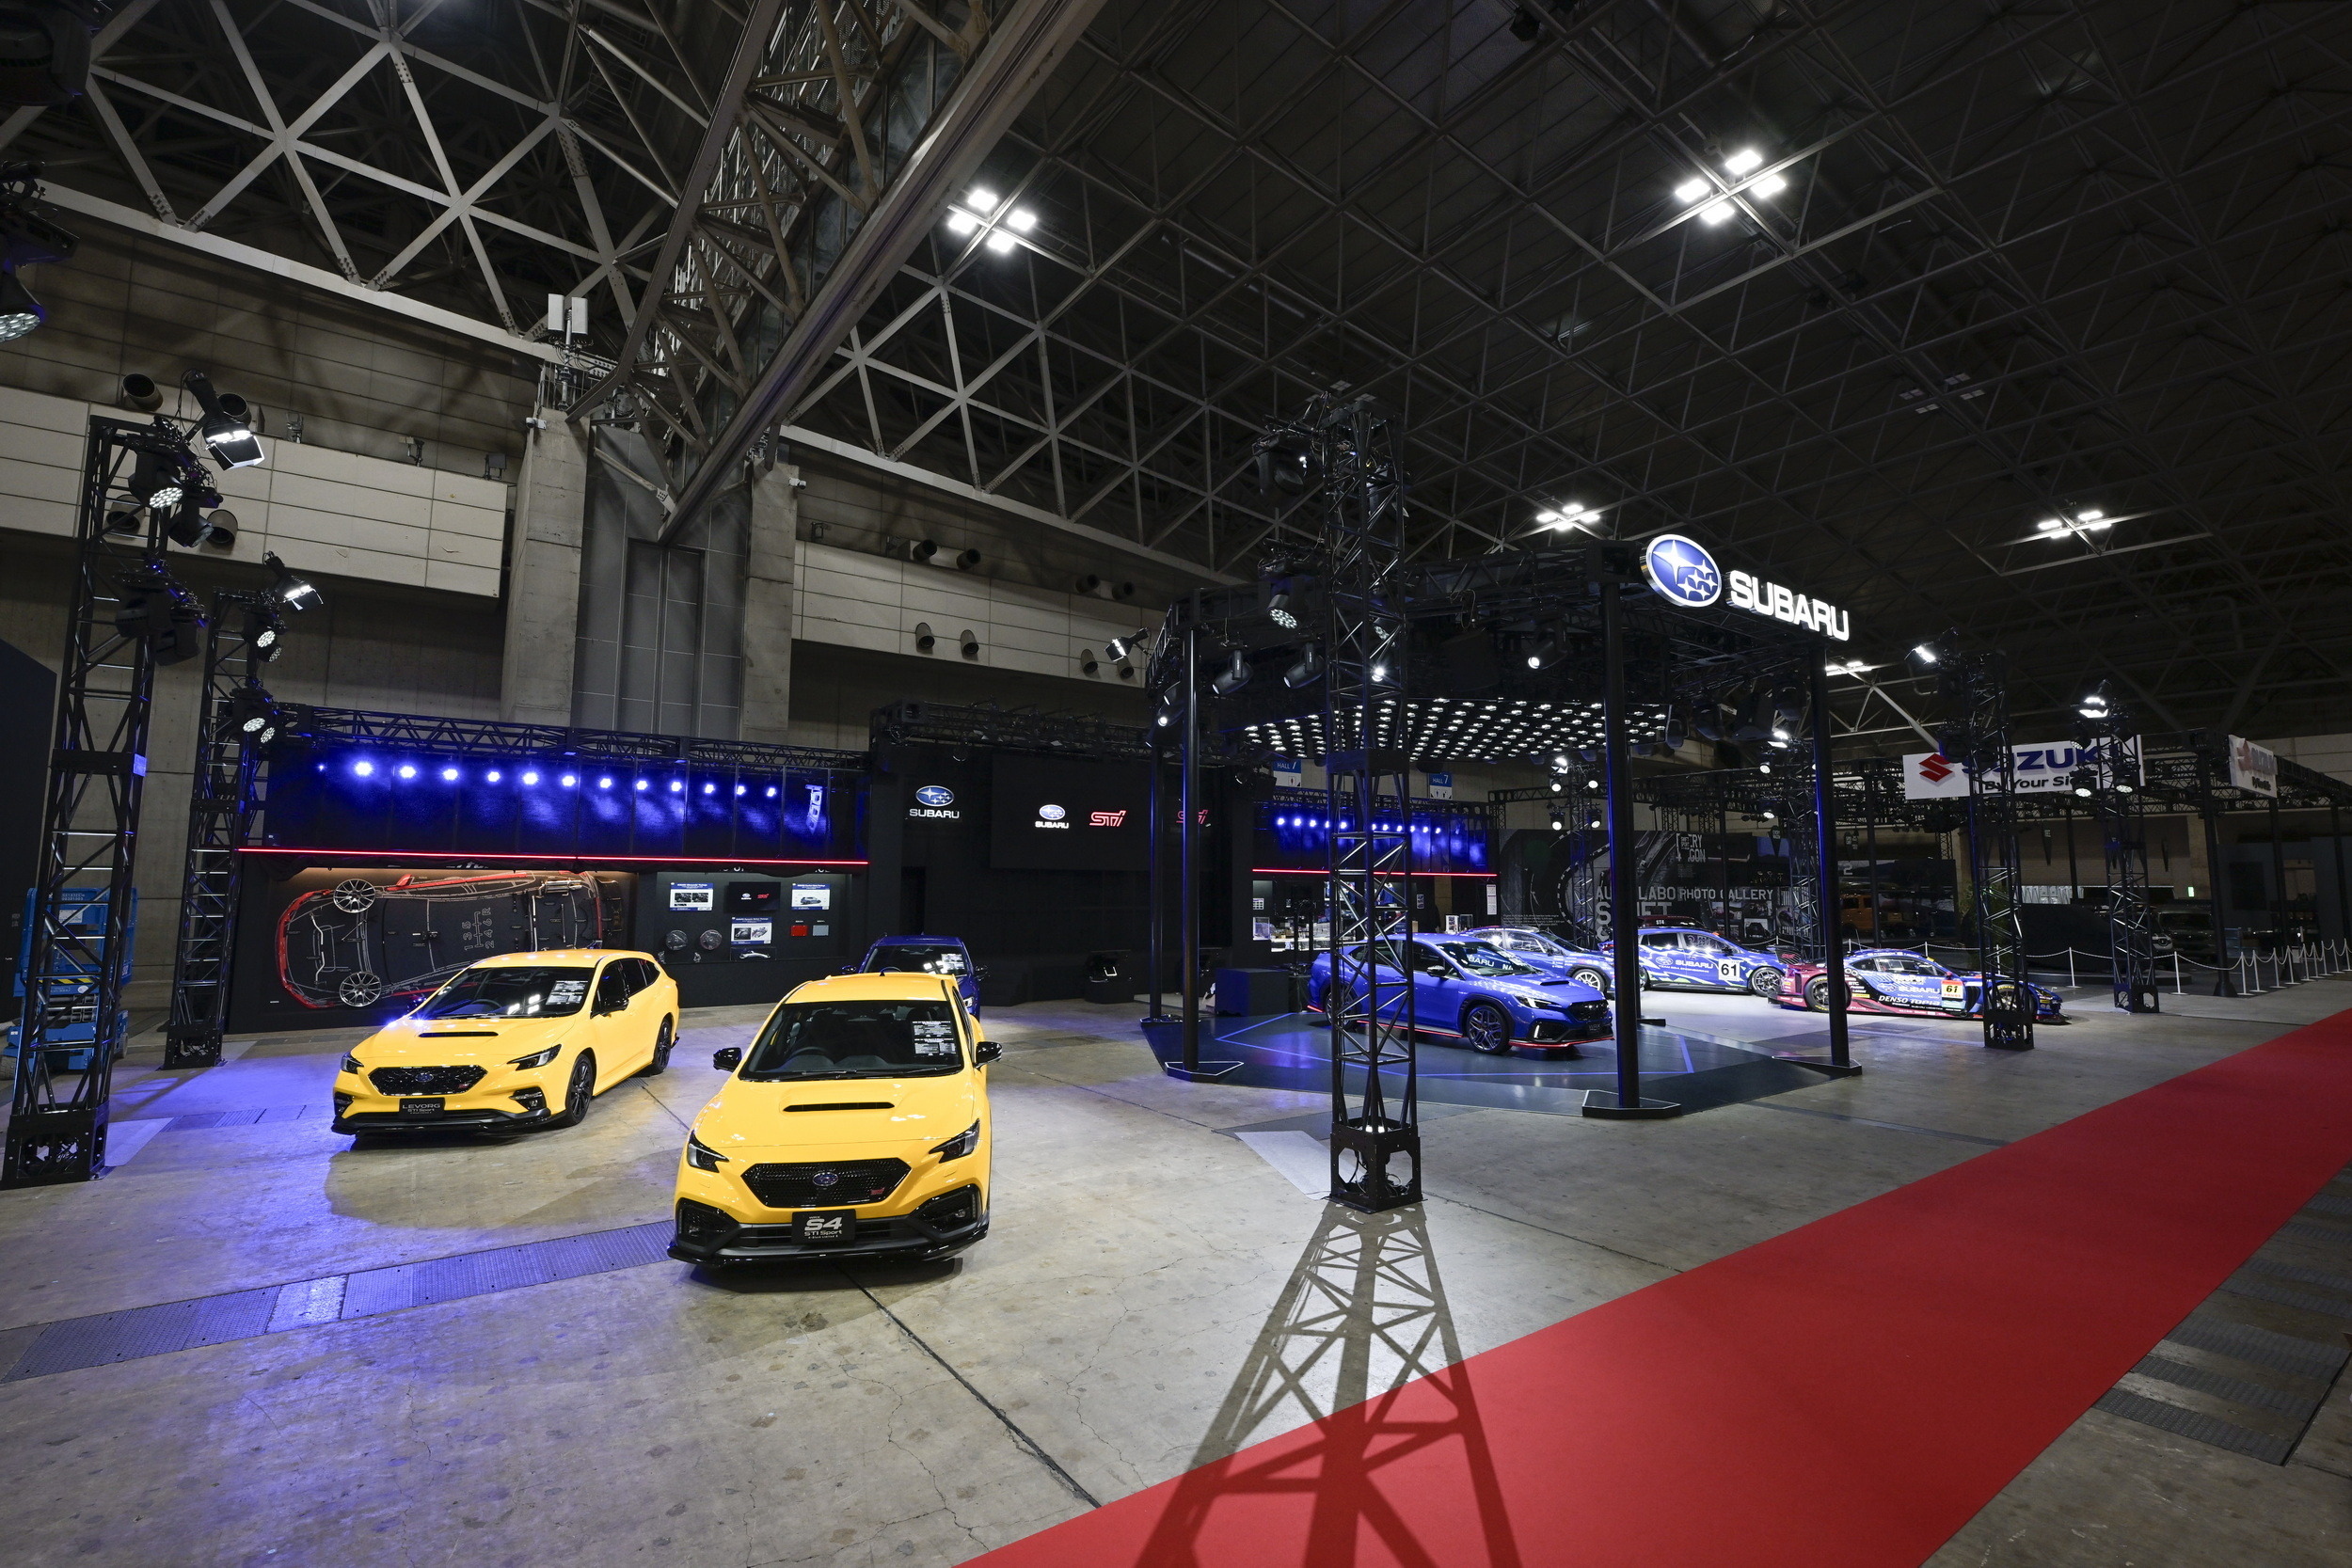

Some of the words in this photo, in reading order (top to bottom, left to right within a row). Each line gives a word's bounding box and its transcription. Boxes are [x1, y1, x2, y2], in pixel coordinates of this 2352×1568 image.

[1730, 570, 1850, 641] SUBARU
[1444, 774, 1449, 784] 7
[2053, 776, 2076, 787] Si
[909, 808, 960, 819] SUBARU
[1035, 821, 1070, 830] SUBARU
[1638, 886, 1677, 900] LABO
[1679, 889, 1716, 900] PHOTO
[1468, 957, 1495, 967] BARU
[1676, 960, 1713, 969] SUBARU
[1721, 963, 1737, 976] 61
[1899, 986, 1940, 994] SUBARU
[1946, 985, 1958, 994] 61
[1879, 995, 1908, 1004] DENSO
[804, 1217, 842, 1230] S4
